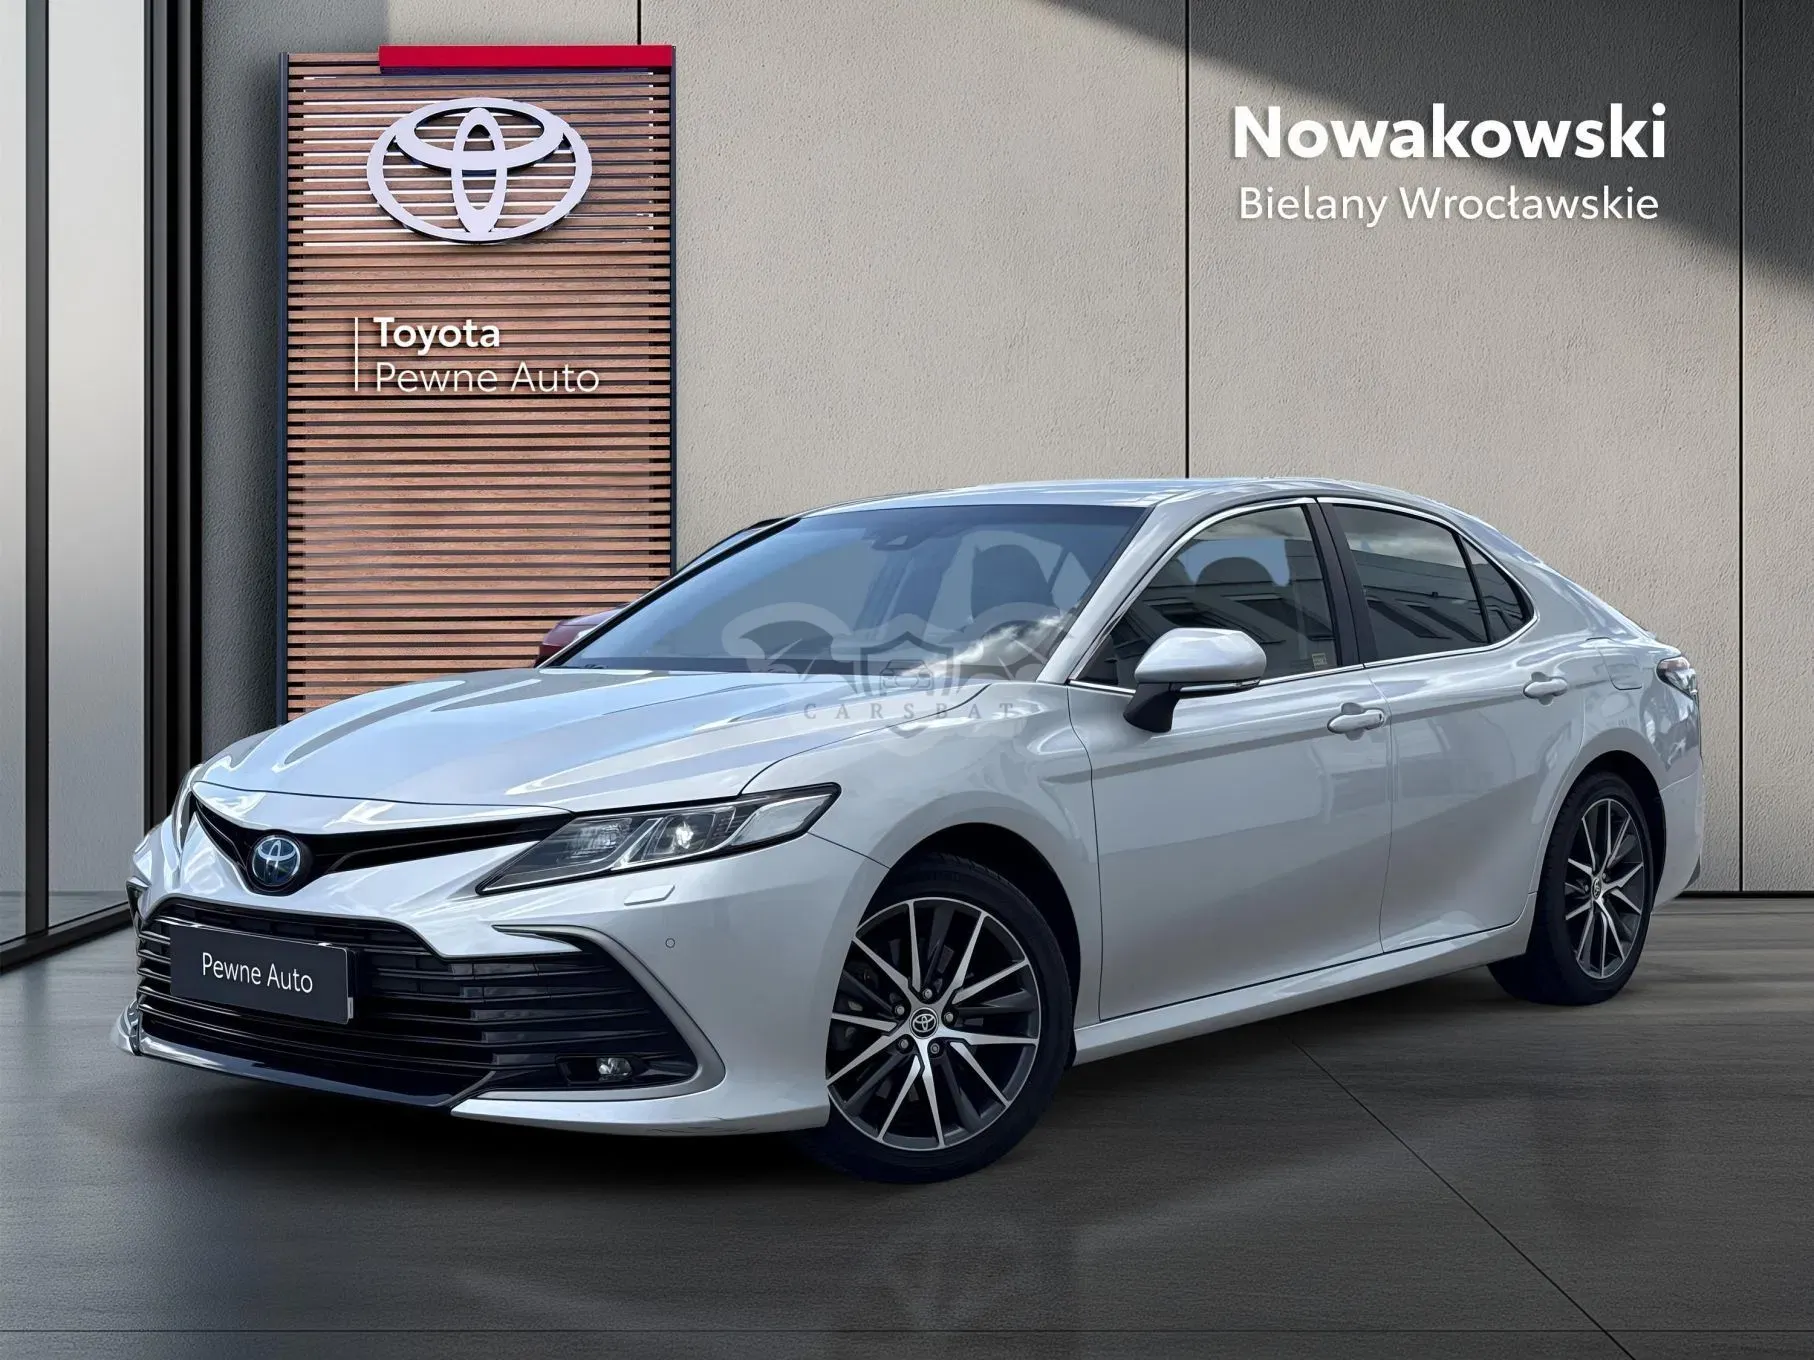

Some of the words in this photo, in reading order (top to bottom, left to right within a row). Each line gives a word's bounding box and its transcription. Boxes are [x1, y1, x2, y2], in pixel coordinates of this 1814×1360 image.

[1234, 102, 1666, 158] Nowakowski
[1240, 185, 1387, 227] Bielany
[1399, 185, 1659, 219] Wrocławskie
[373, 316, 500, 356] Toyota
[376, 361, 498, 392] Pewne
[510, 361, 600, 392] Auto
[202, 952, 261, 985] Pewne
[267, 963, 313, 993] Auto
